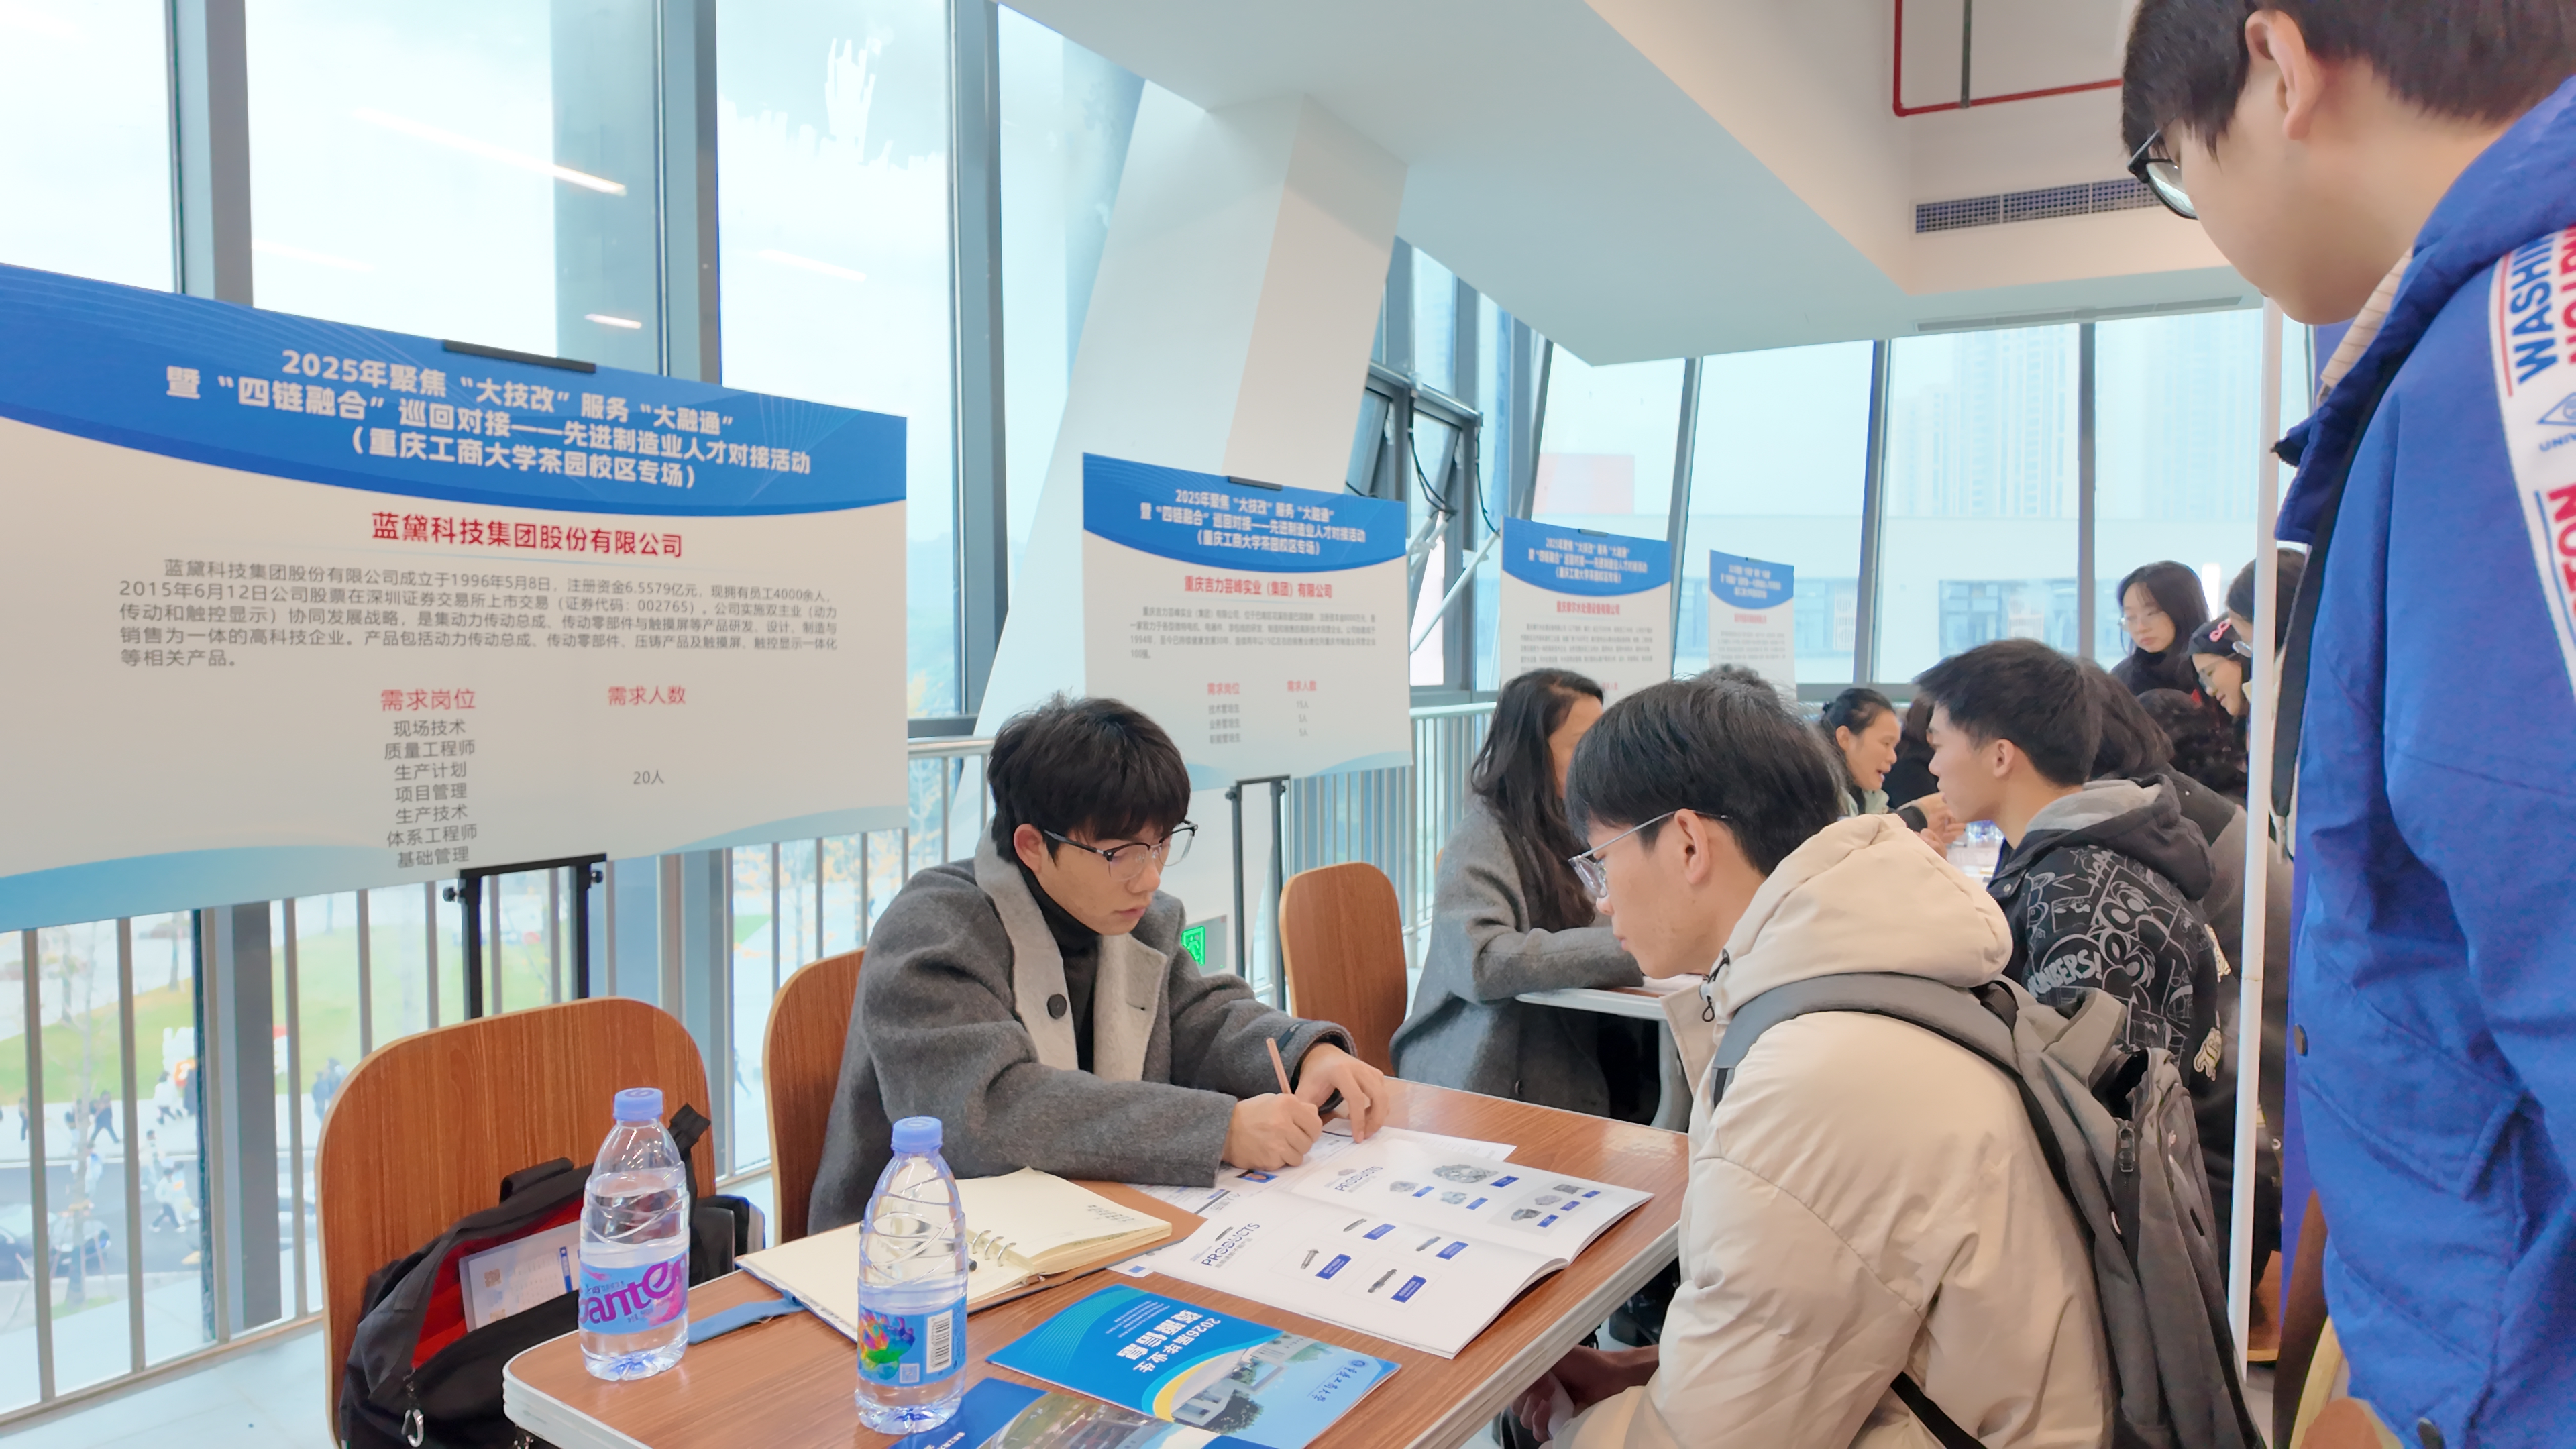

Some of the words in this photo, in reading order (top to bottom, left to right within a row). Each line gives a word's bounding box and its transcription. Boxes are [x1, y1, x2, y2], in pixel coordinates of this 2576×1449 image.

[372, 512, 683, 557] 蓝黛科技集团股份有限公司
[120, 648, 237, 667] 等相关产品。
[608, 685, 686, 706] 需求人数
[1208, 682, 1240, 696] 需求岗位
[1287, 680, 1316, 692] 需求人数
[380, 688, 476, 712] 需求岗位
[392, 718, 466, 737] 现场技术
[384, 739, 476, 760] 质量工程师
[394, 761, 467, 781] 生产计划
[633, 769, 665, 786] 20人
[394, 782, 468, 804] 项目管理
[395, 804, 468, 825] 生产技术
[386, 824, 478, 847] 体系工程师
[397, 847, 469, 868] 基础管理
[1334, 1165, 1384, 1193] PRODUCTS
[1200, 1222, 1261, 1267] PRODUCTS
[1116, 1309, 1203, 1360] 资源信息
[1133, 1316, 1222, 1374] 2026届毕业生
